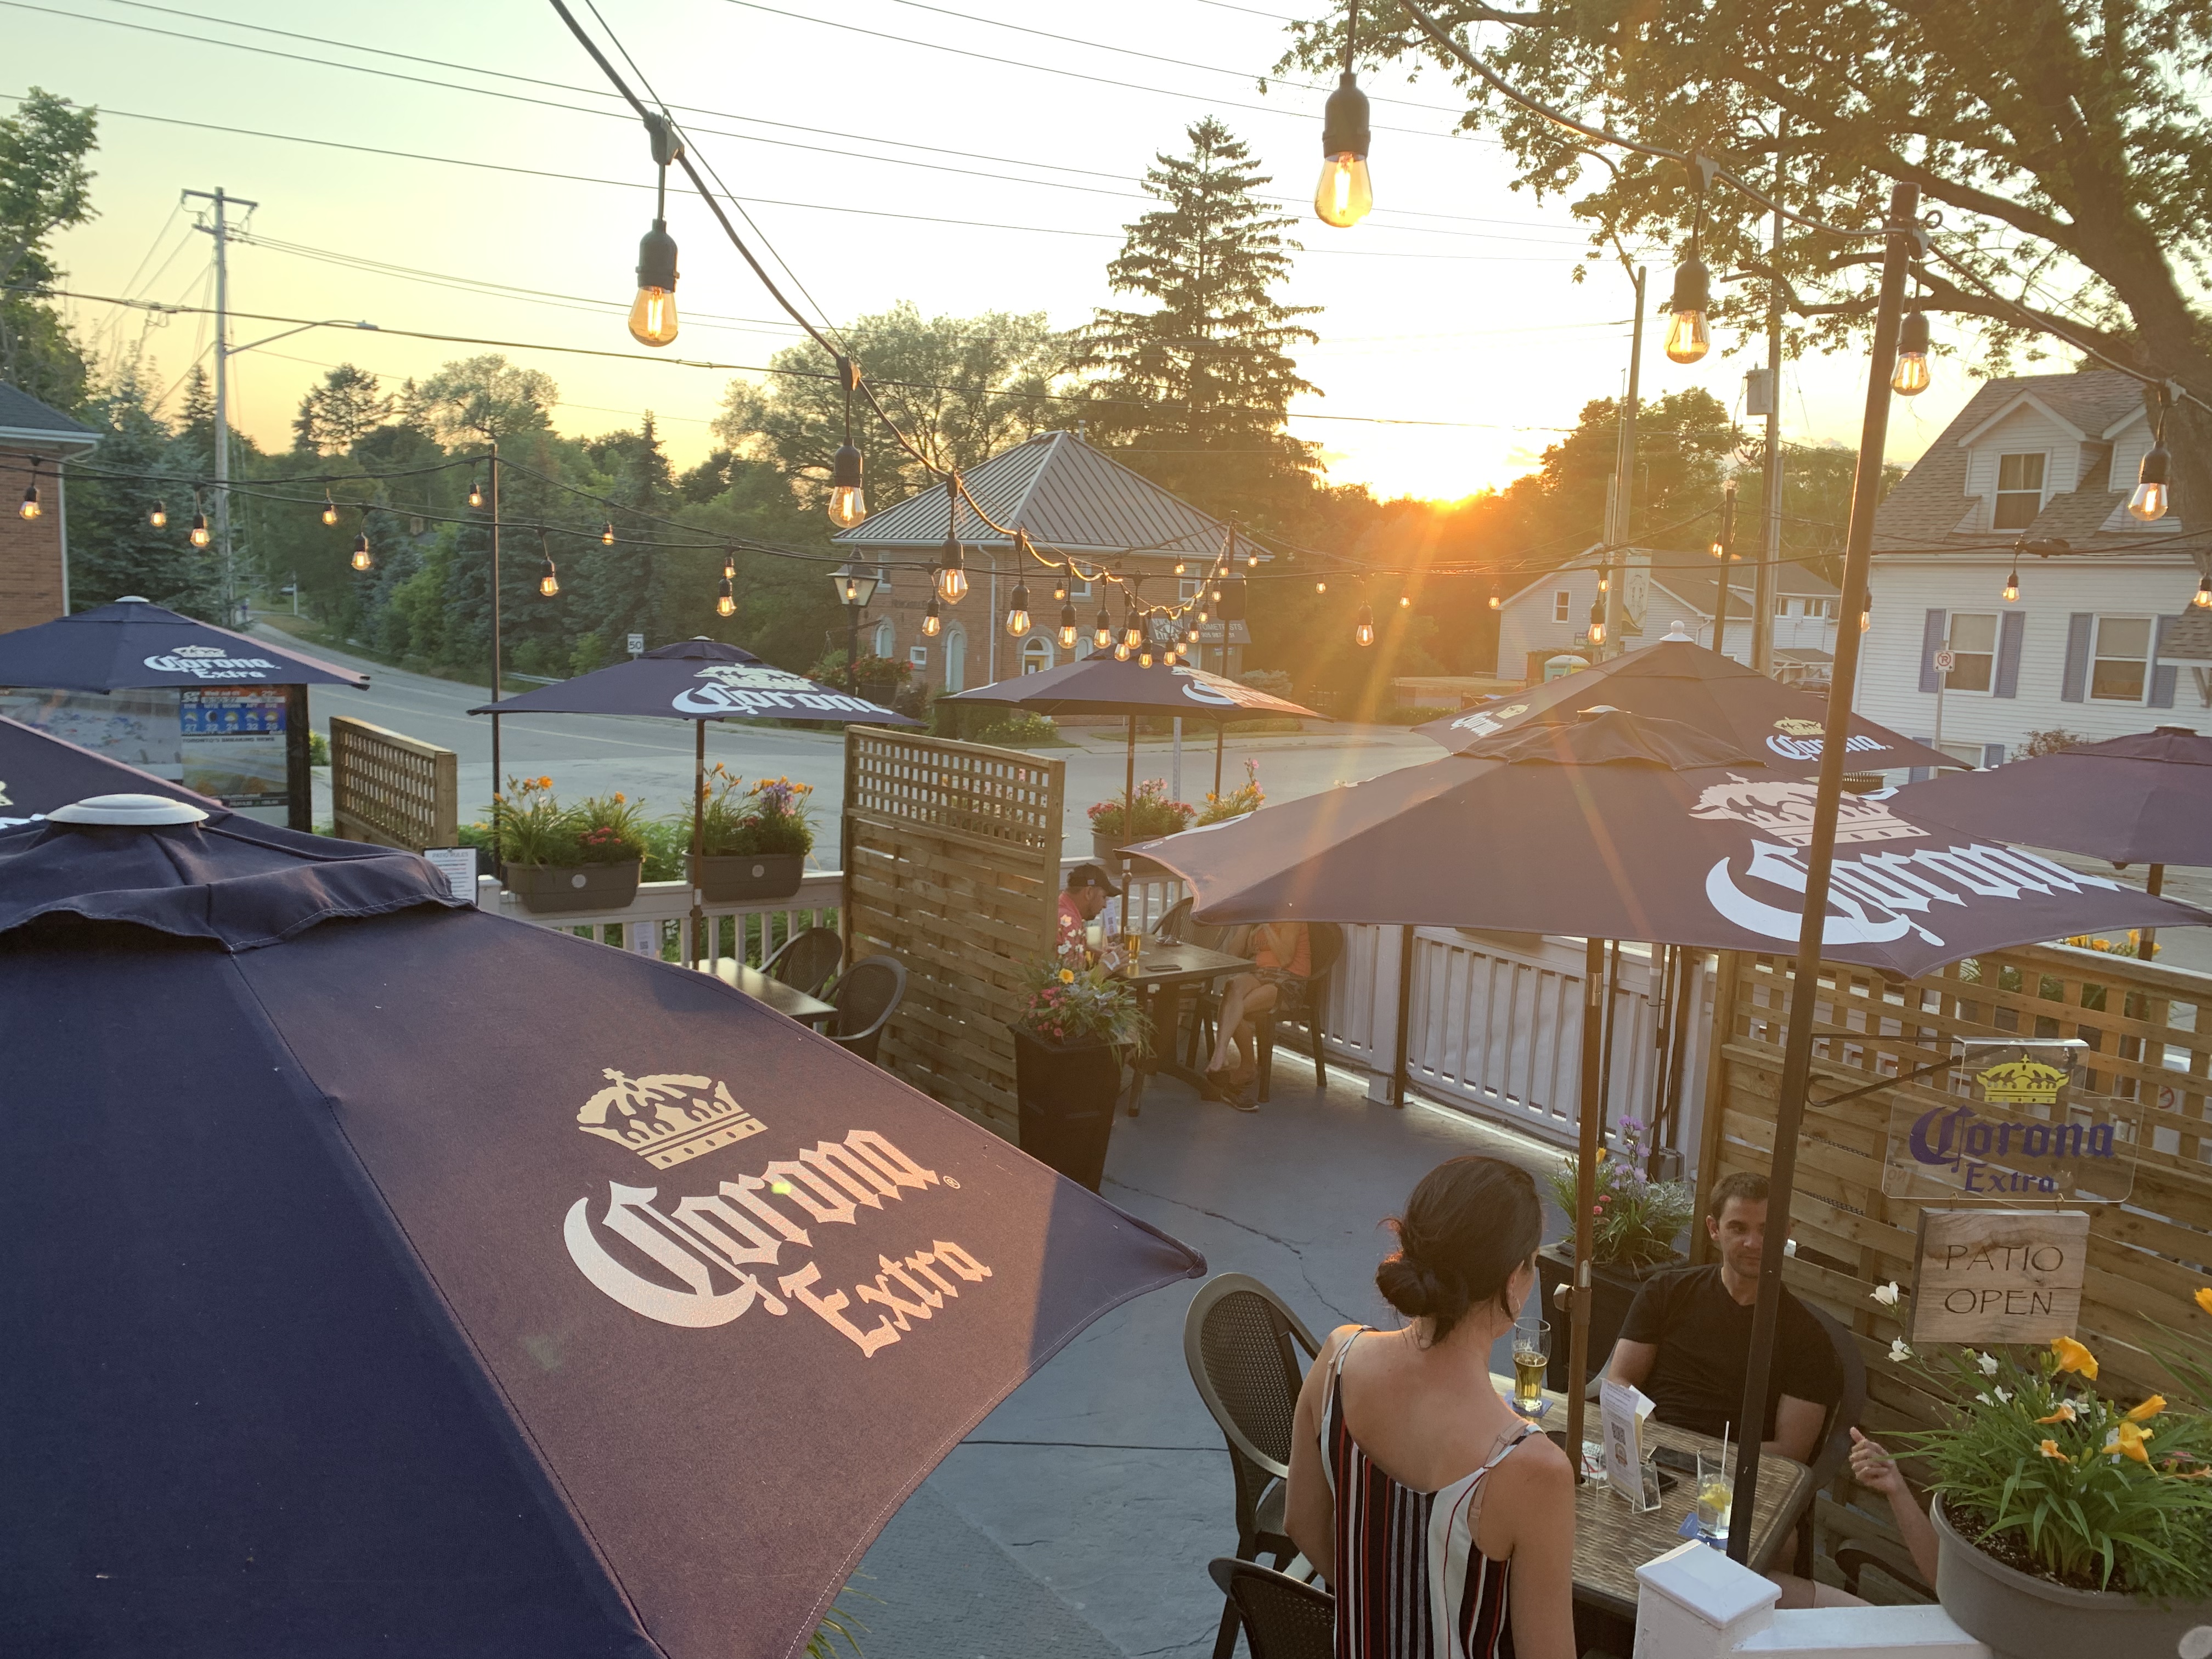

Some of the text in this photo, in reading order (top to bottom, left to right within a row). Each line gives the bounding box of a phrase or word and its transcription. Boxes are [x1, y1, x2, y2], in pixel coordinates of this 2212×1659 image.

[629, 641, 642, 650] 50
[143, 656, 275, 673] Corona
[190, 668, 266, 679] Extra
[1909, 1104, 2115, 1173] Corona
[1964, 1163, 2055, 1193] Extra
[563, 1130, 939, 1328] Corona
[1945, 1245, 2063, 1272] PATIO
[778, 1239, 992, 1358] Extra
[1945, 1289, 2053, 1316] OPEN
